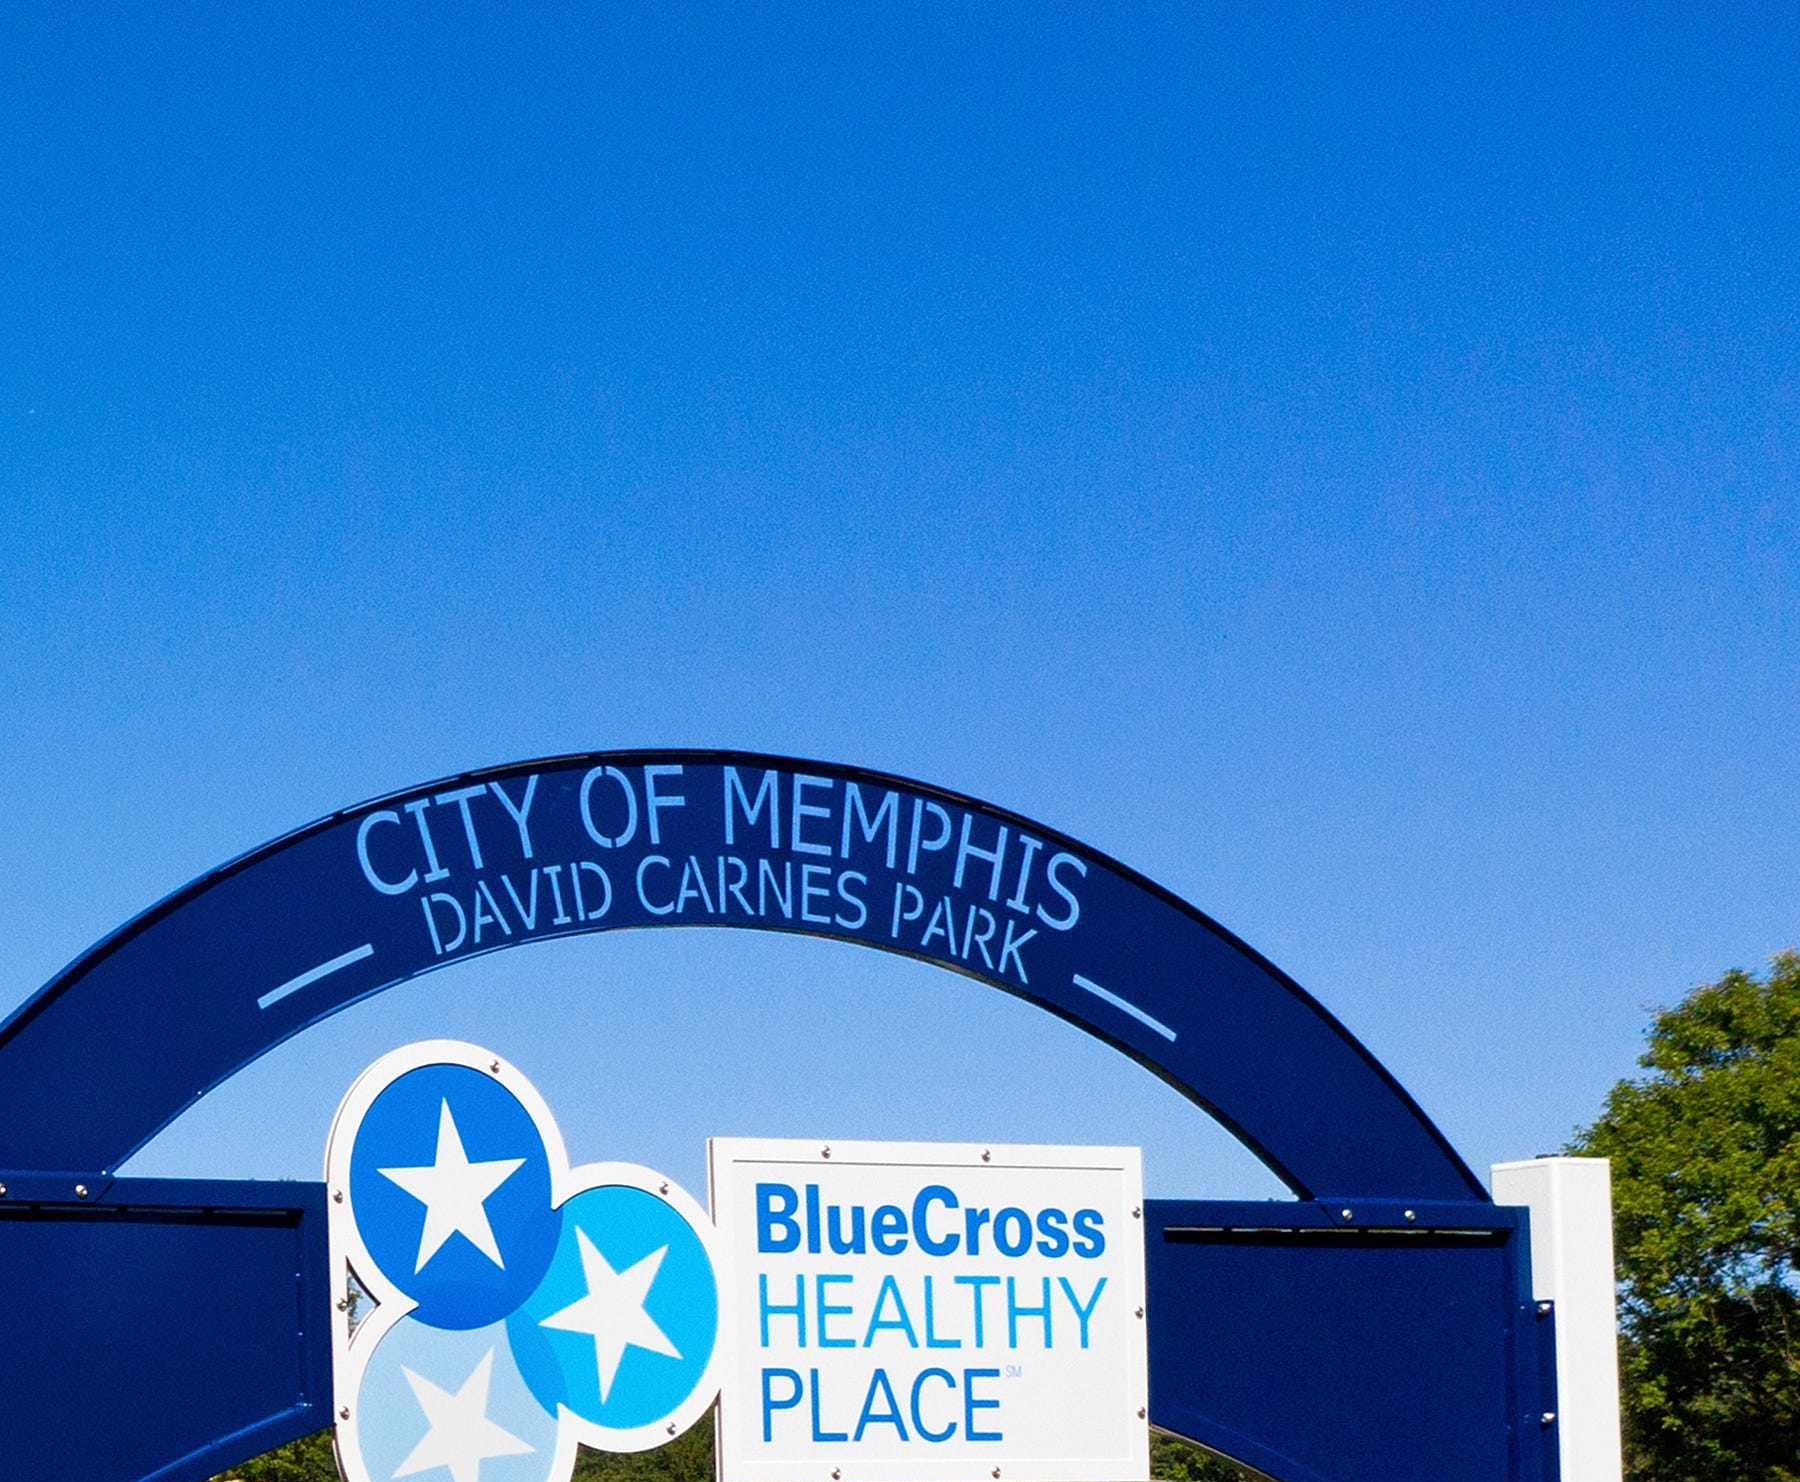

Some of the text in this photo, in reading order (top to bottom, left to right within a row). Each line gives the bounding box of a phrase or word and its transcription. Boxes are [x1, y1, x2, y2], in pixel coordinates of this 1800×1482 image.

[356, 764, 1088, 931] CITY OF MEMPHIS
[420, 854, 1038, 985] DAVID CARNES PARK
[755, 1182, 1106, 1259] BlueCross
[758, 1273, 1109, 1350] HEALTHY
[760, 1366, 1004, 1444] PLACE
